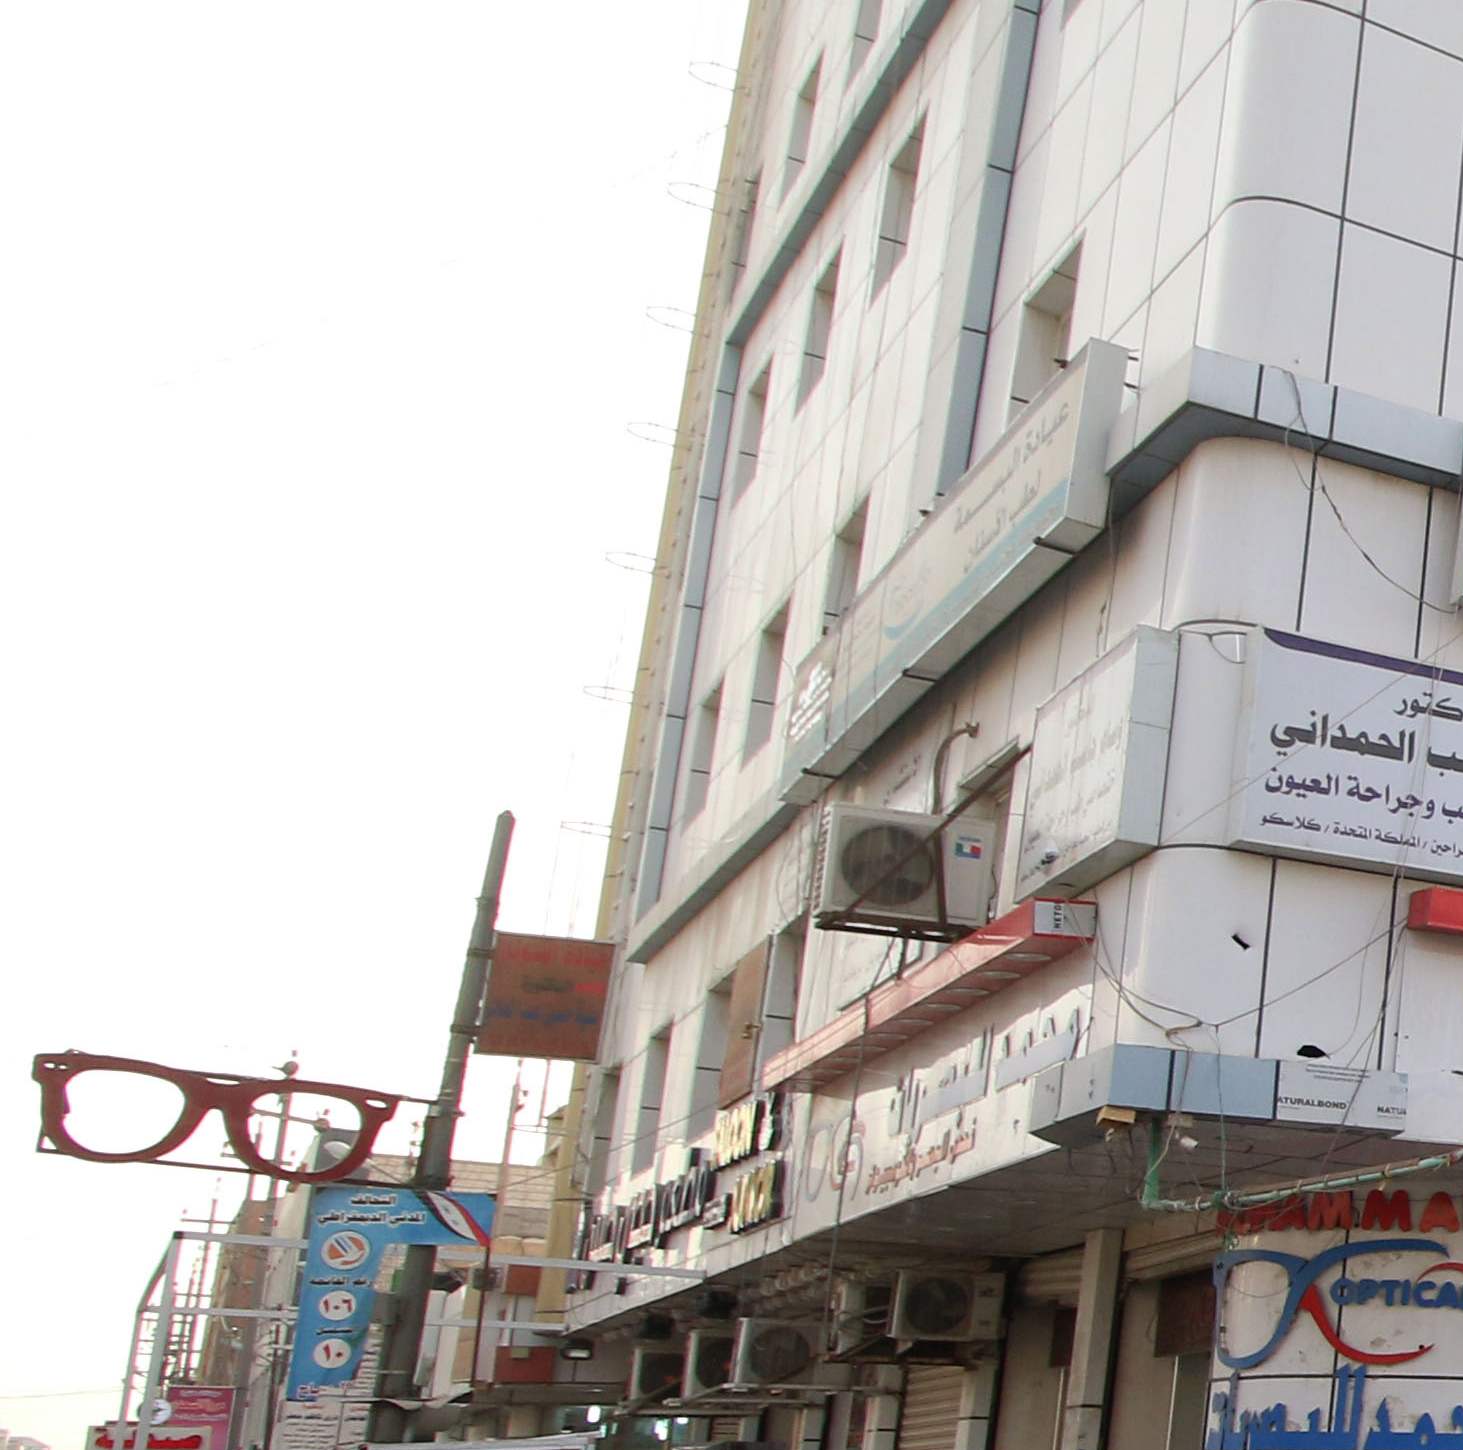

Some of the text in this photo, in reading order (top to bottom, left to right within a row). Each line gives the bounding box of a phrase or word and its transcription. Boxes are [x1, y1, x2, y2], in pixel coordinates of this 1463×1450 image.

[1270, 710, 1415, 765] الحمداني
[1264, 767, 1340, 799] العيون
[1346, 775, 1435, 820] وجراحة
[1260, 813, 1321, 833] كلاسكو
[1333, 821, 1371, 841] المتحدة
[1375, 829, 1421, 848] المملكة
